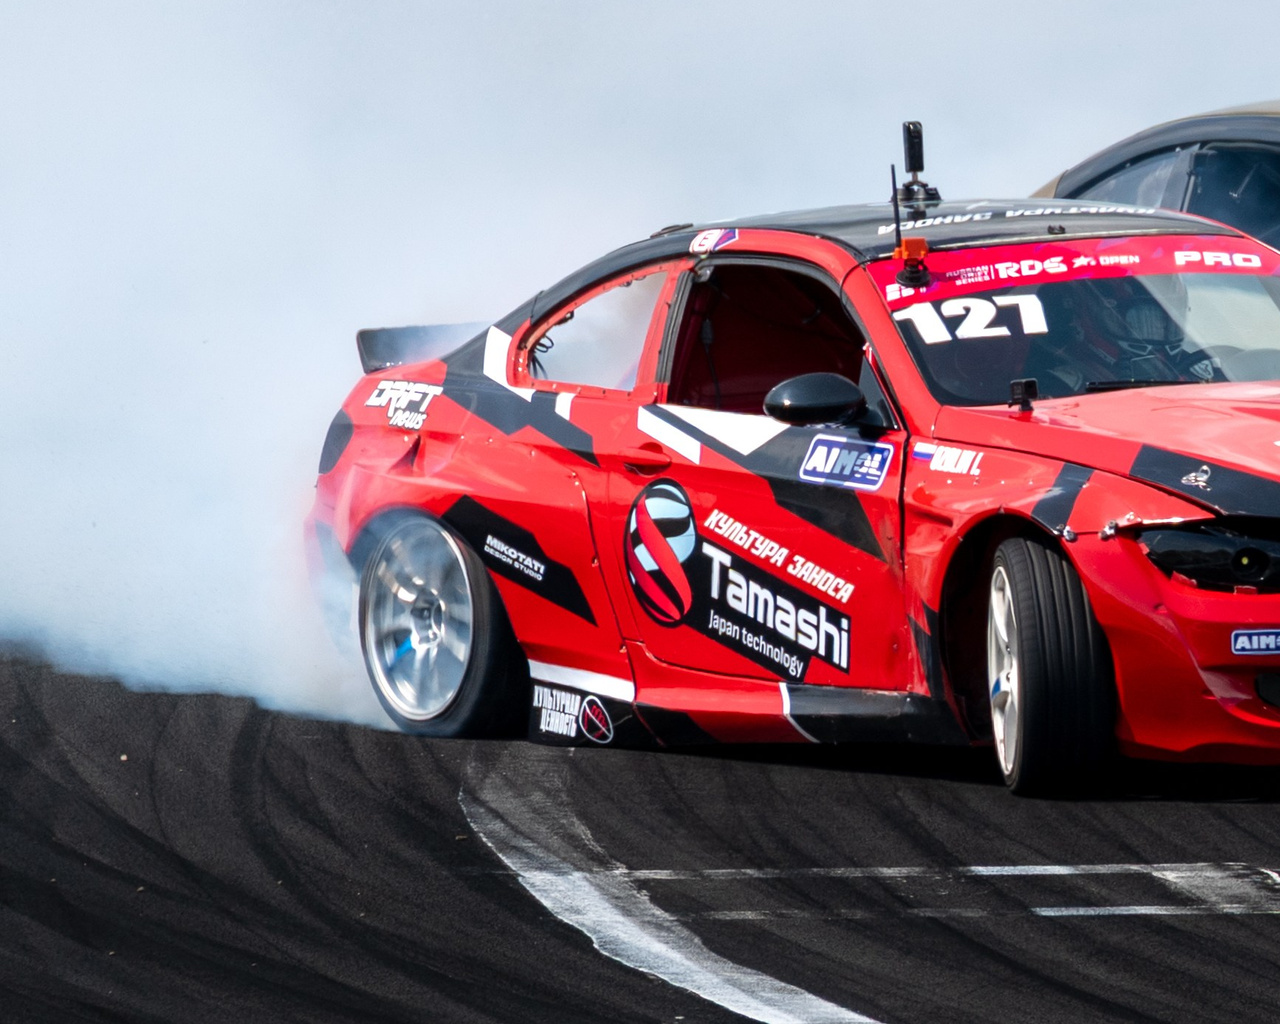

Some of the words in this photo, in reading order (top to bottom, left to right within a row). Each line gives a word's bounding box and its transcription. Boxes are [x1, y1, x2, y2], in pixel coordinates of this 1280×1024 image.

[995, 256, 1068, 278] RDS
[1098, 255, 1140, 265] OPEN
[1174, 251, 1262, 267] PRO
[955, 276, 991, 286] SERIES
[892, 293, 1049, 345] 127
[364, 380, 444, 418] DRIFT
[483, 544, 513, 565] DESIGN
[513, 560, 543, 581] STUDIO
[486, 534, 546, 574] MIKOTATI
[704, 509, 789, 567] КУЛЬТУРА
[787, 556, 855, 603] ЗАНОСА
[702, 541, 849, 668] Tamashi
[708, 609, 740, 640] Japan
[742, 626, 803, 678] technology
